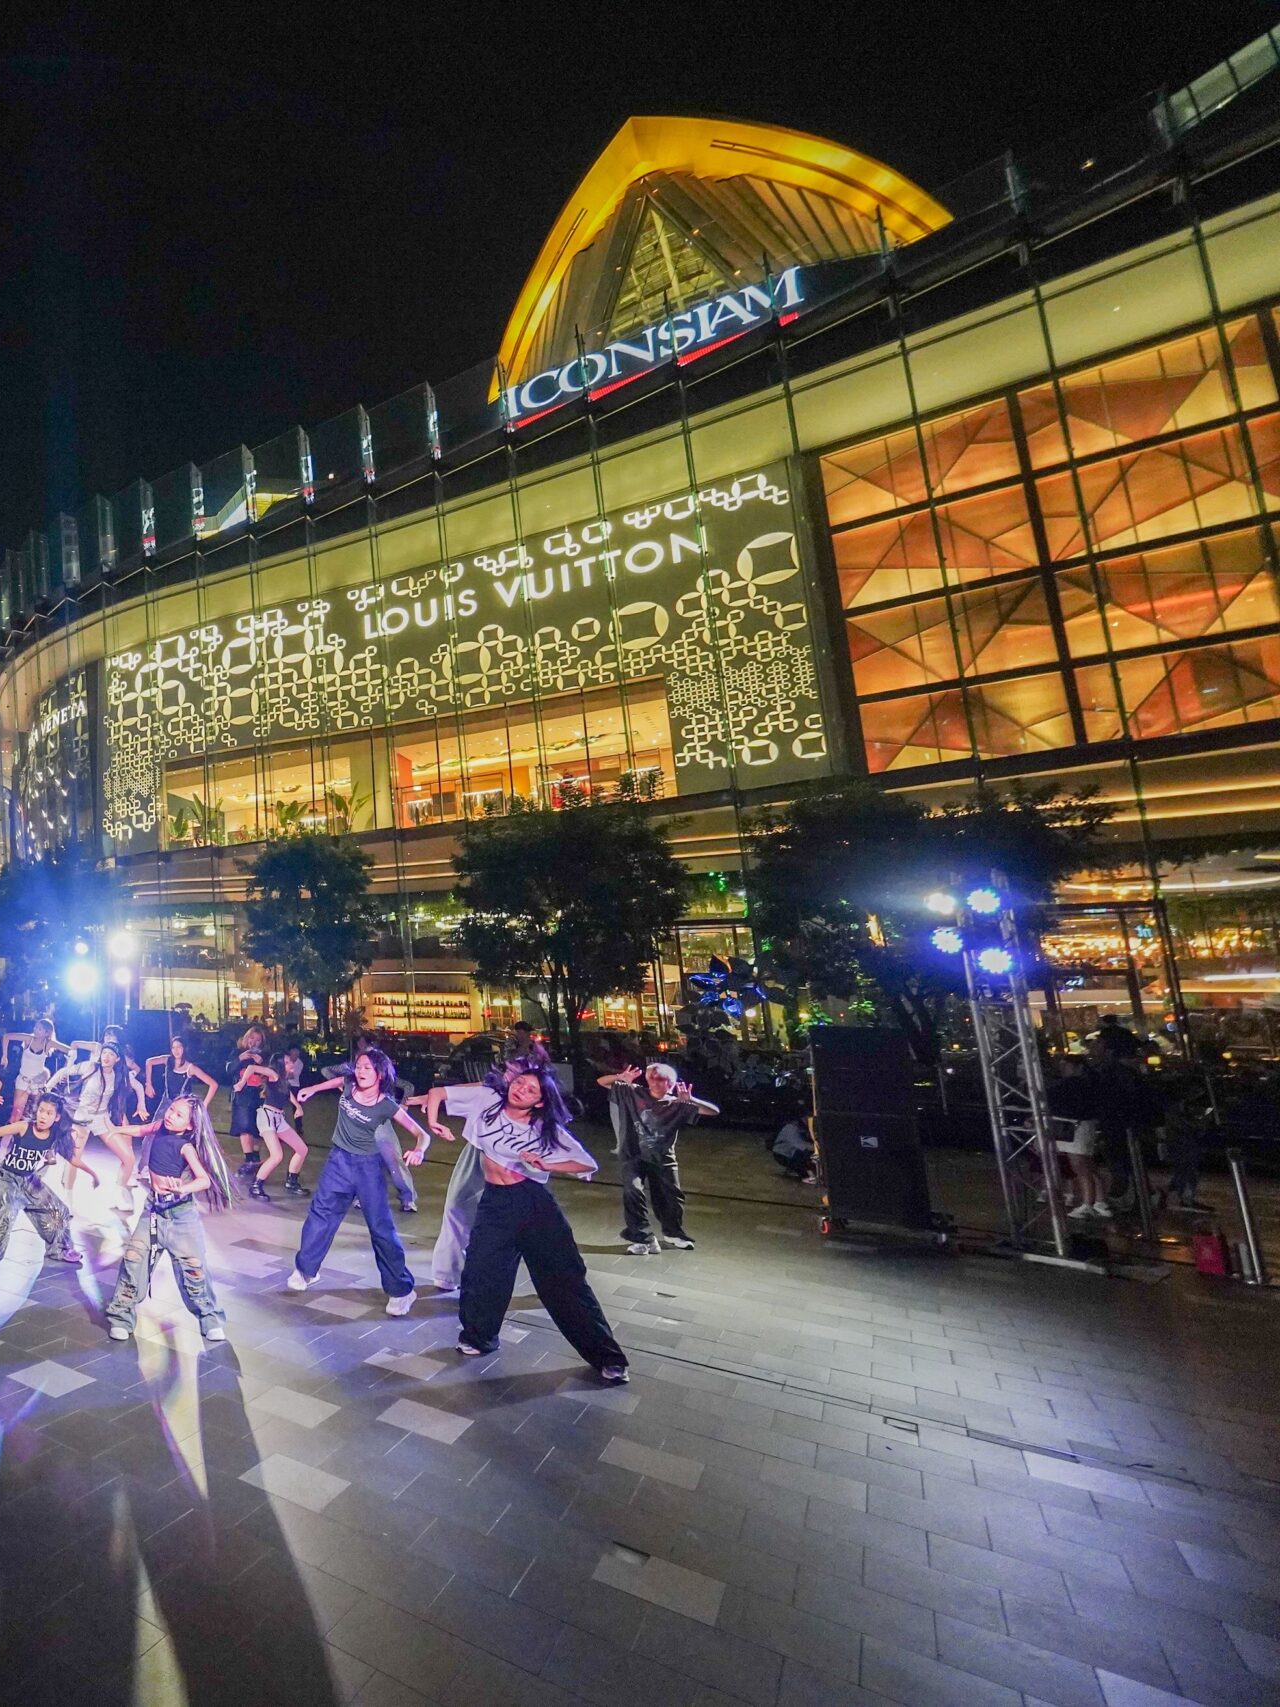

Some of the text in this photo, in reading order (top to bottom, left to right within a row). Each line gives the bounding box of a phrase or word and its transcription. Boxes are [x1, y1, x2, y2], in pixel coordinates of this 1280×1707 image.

[506, 265, 806, 419] ICONSIAM
[363, 526, 709, 640] LOUIS VUITTON
